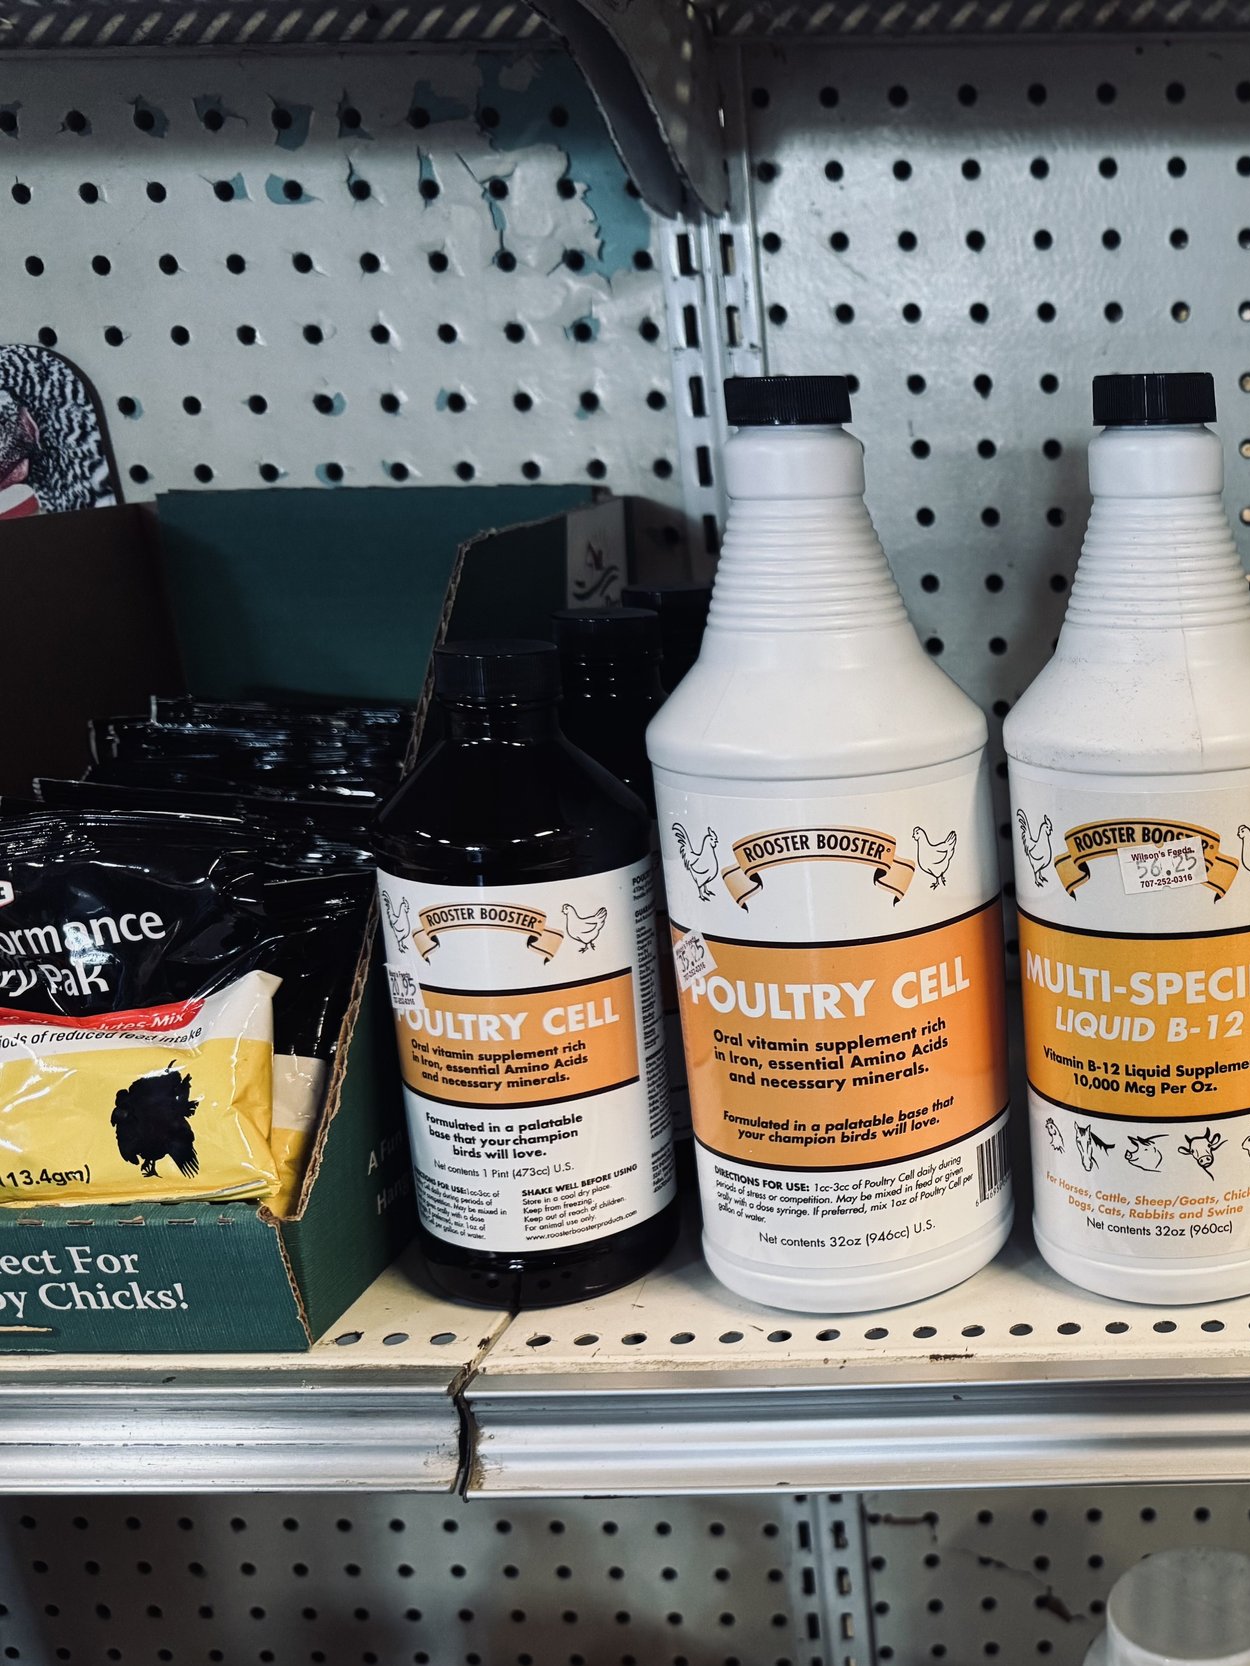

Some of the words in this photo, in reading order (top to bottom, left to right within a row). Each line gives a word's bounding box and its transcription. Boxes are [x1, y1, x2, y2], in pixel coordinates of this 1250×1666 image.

[742, 834, 810, 863] ROOSTER
[816, 833, 886, 860] BOOSTER
[1073, 827, 1136, 852] ROOSTER
[1131, 851, 1165, 861] Wilson's
[1140, 874, 1192, 888] 707-252-0316
[426, 907, 475, 927] ROOSTER
[480, 907, 537, 929] BOOSTER
[691, 976, 876, 1020] POULTRY
[891, 956, 970, 1009] CELL
[543, 997, 619, 1035] CELL
[1055, 1006, 1155, 1042] LIQUID
[1167, 1010, 1244, 1043] B-12
[31, 1031, 49, 1044] of
[50, 1031, 119, 1042] reduced
[158, 1027, 202, 1043] intake
[713, 1029, 742, 1047] Oral
[747, 1038, 808, 1051] vitamin
[815, 1027, 917, 1054] supplement
[921, 1017, 946, 1036] rich
[715, 1047, 725, 1060] in
[730, 1051, 763, 1069] Iron,
[768, 1056, 844, 1070] essential
[851, 1050, 906, 1069] Amino
[912, 1036, 948, 1057] Acids
[1043, 1046, 1083, 1070] Vitamin
[1088, 1060, 1120, 1075] B-12
[1125, 1064, 1171, 1080] Liquid
[729, 1070, 755, 1085] and
[761, 1076, 846, 1092] necessary
[852, 1062, 929, 1087] minerals.
[1073, 1073, 1120, 1092] 10,000
[1125, 1081, 1156, 1097] Mcg
[1161, 1081, 1186, 1094] Per
[1191, 1080, 1217, 1093] Oz.
[426, 1112, 484, 1132] Formulated
[489, 1123, 500, 1132] in
[519, 1114, 583, 1133] palatable
[429, 1126, 450, 1141] base
[453, 1133, 476, 1144] that
[453, 1145, 481, 1158] birds
[485, 1149, 508, 1159] will
[513, 1148, 547, 1159] love.
[522, 1187, 553, 1196] SHAKE
[556, 1182, 578, 1192] WELL
[581, 1173, 611, 1187] BEFORE
[614, 1164, 637, 1177] USING
[715, 1165, 760, 1187] DIRECTIONS
[763, 1180, 782, 1190] FOR
[786, 1183, 810, 1192] USE:
[814, 1183, 849, 1192] 1cc-3cc
[852, 1179, 862, 1190] of
[865, 1173, 896, 1189] Poultry
[899, 1169, 915, 1183] Cell
[917, 1163, 936, 1178] daily
[939, 1155, 961, 1171] during
[1046, 1171, 1057, 1184] For
[1059, 1179, 1092, 1198] Horses,
[1096, 1191, 1130, 1205] Cattle,
[1135, 1195, 1219, 1208] Sheep/Goats,
[1068, 1196, 1094, 1211] Dogs,
[1098, 1205, 1124, 1218] Cats,
[1129, 1209, 1174, 1220] Rabbits
[1179, 1208, 1203, 1219] and
[1207, 1203, 1244, 1217] Swine
[1086, 1216, 1104, 1230] Net
[1107, 1223, 1151, 1236] contents
[1155, 1225, 1186, 1236] 32oz
[1190, 1221, 1233, 1238] (960cc)
[65, 1246, 139, 1274] For
[38, 1282, 189, 1310] Chicks!
